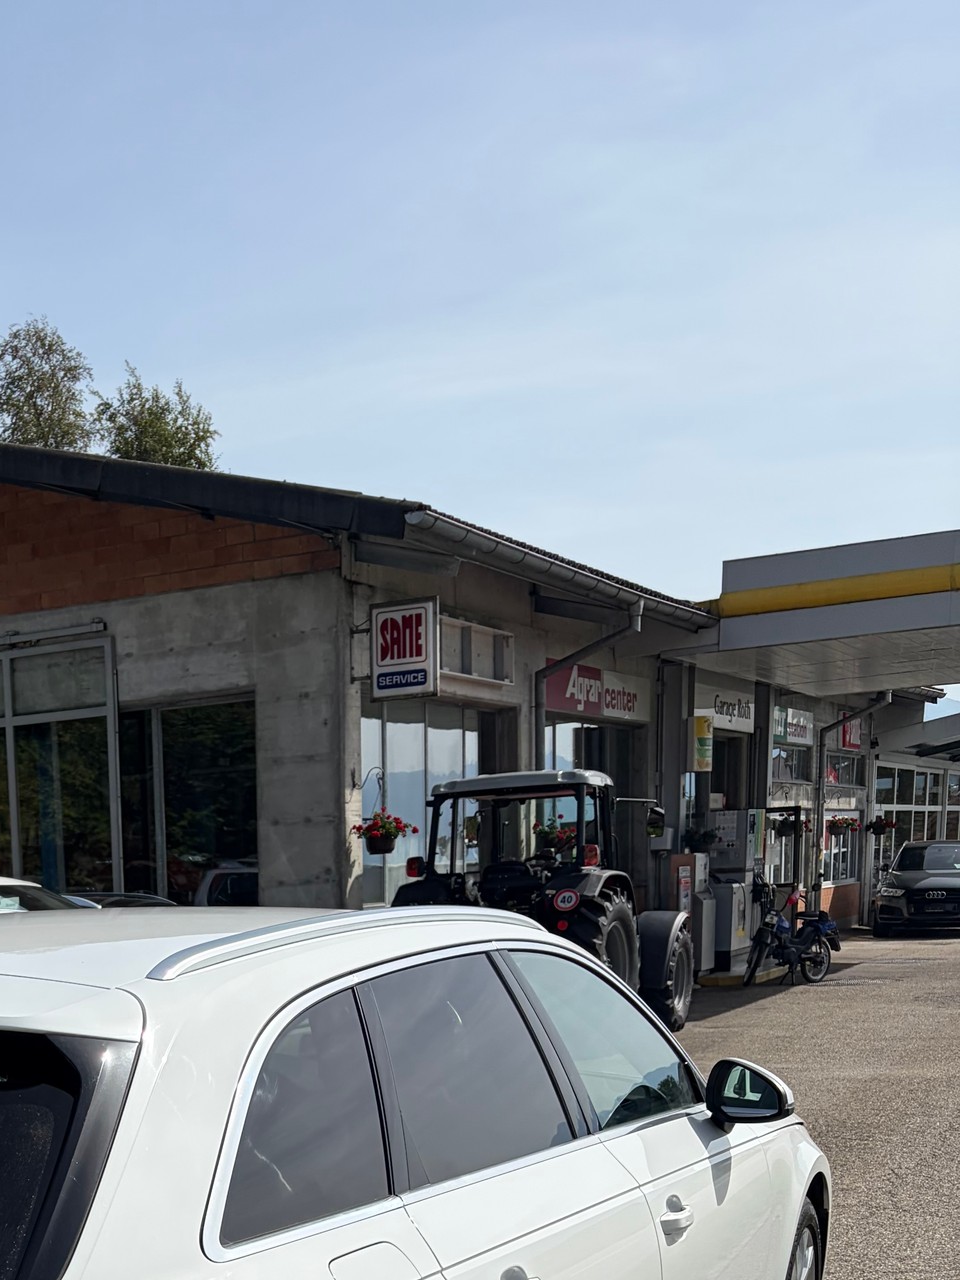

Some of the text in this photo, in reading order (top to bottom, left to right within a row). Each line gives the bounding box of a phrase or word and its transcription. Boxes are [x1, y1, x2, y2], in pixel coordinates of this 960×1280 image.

[380, 613, 422, 662] SAME
[379, 672, 425, 686] SERVICE
[566, 665, 637, 713] Agrar center
[714, 694, 751, 723] Garage Roth
[560, 895, 573, 905] 40
